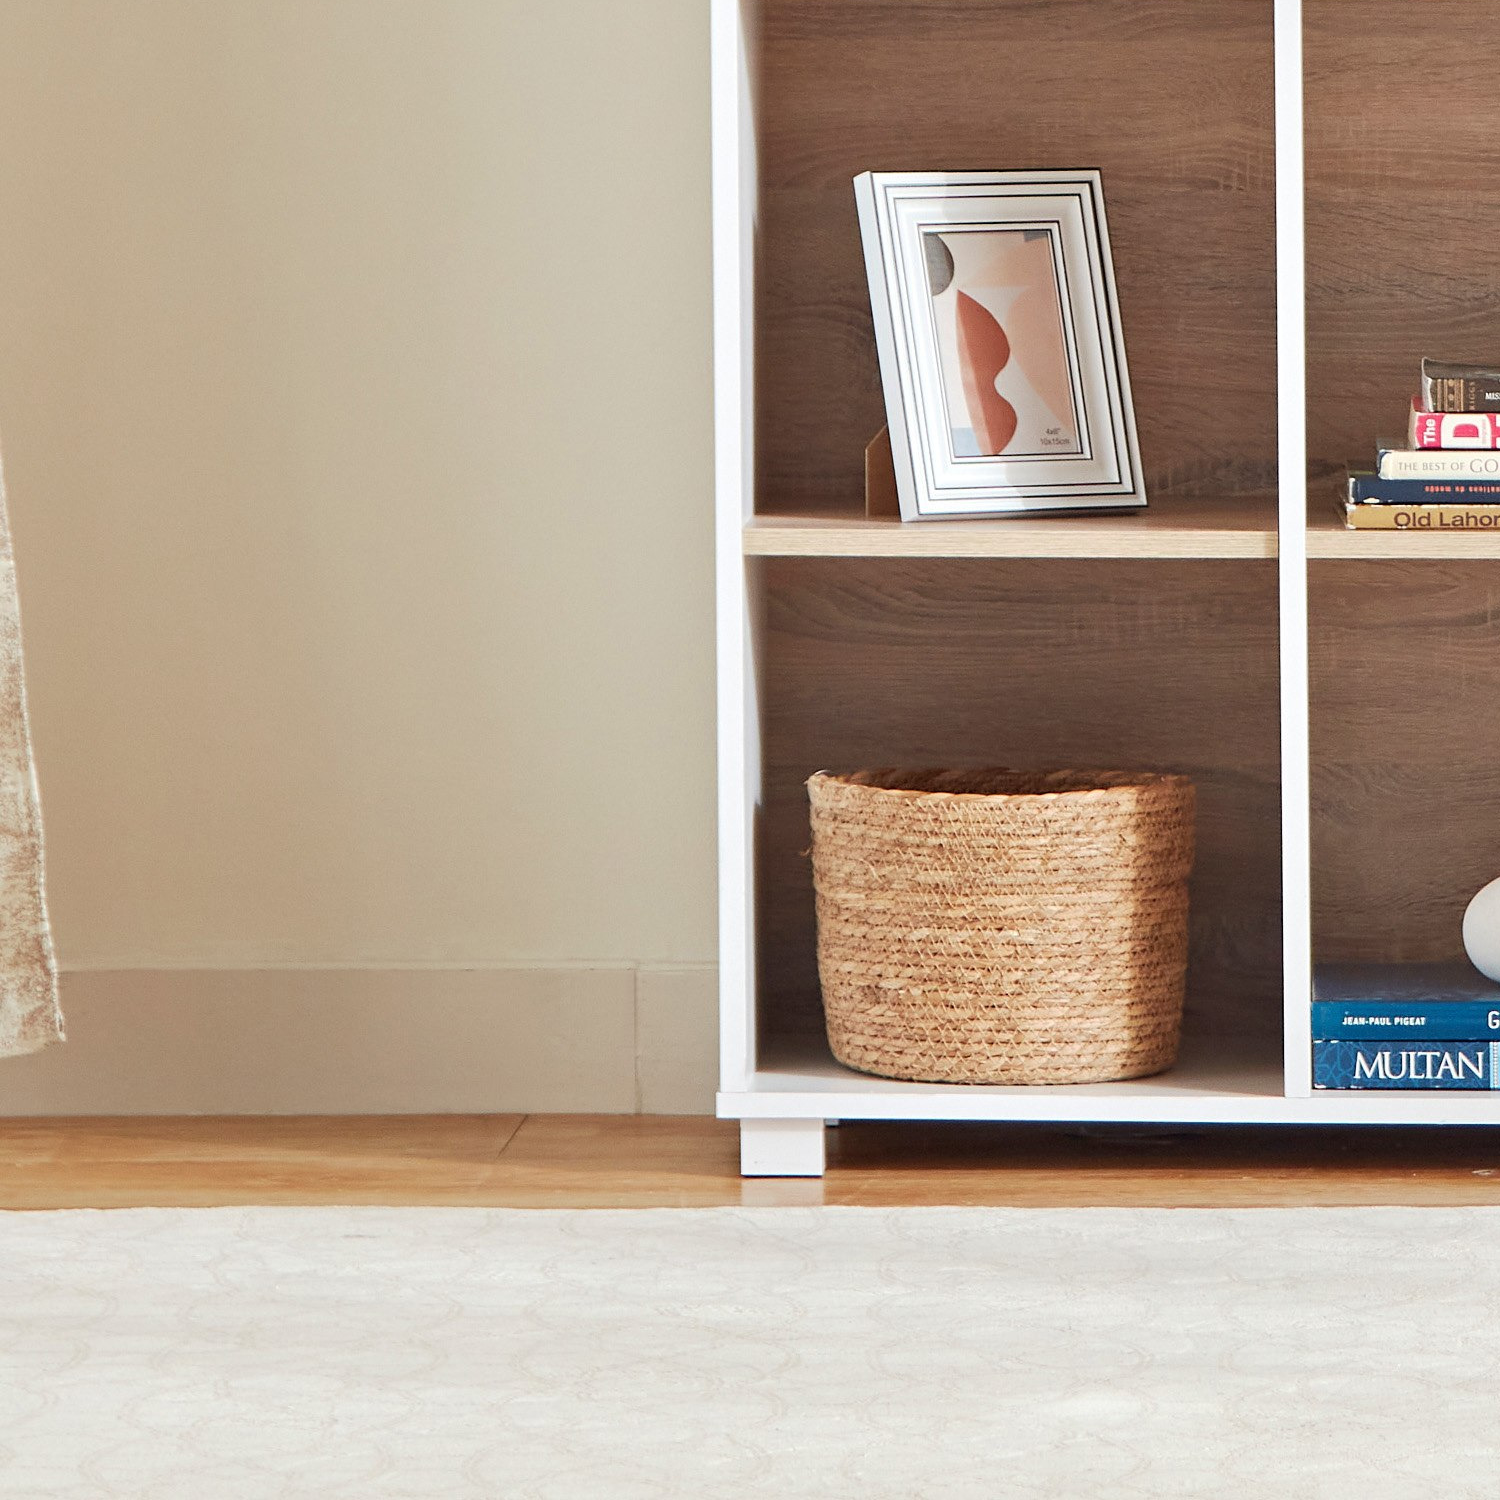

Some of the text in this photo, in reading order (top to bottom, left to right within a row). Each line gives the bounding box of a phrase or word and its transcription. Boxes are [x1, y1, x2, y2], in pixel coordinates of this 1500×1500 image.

[1423, 418, 1437, 445] The
[1398, 462, 1418, 472] THE
[1422, 462, 1446, 472] BEST
[1450, 462, 1465, 472] OF
[1393, 511, 1431, 528] Old
[1341, 1016, 1426, 1026] JEAN-PAUL PIGEAT
[1353, 1051, 1485, 1080] MULTAN
